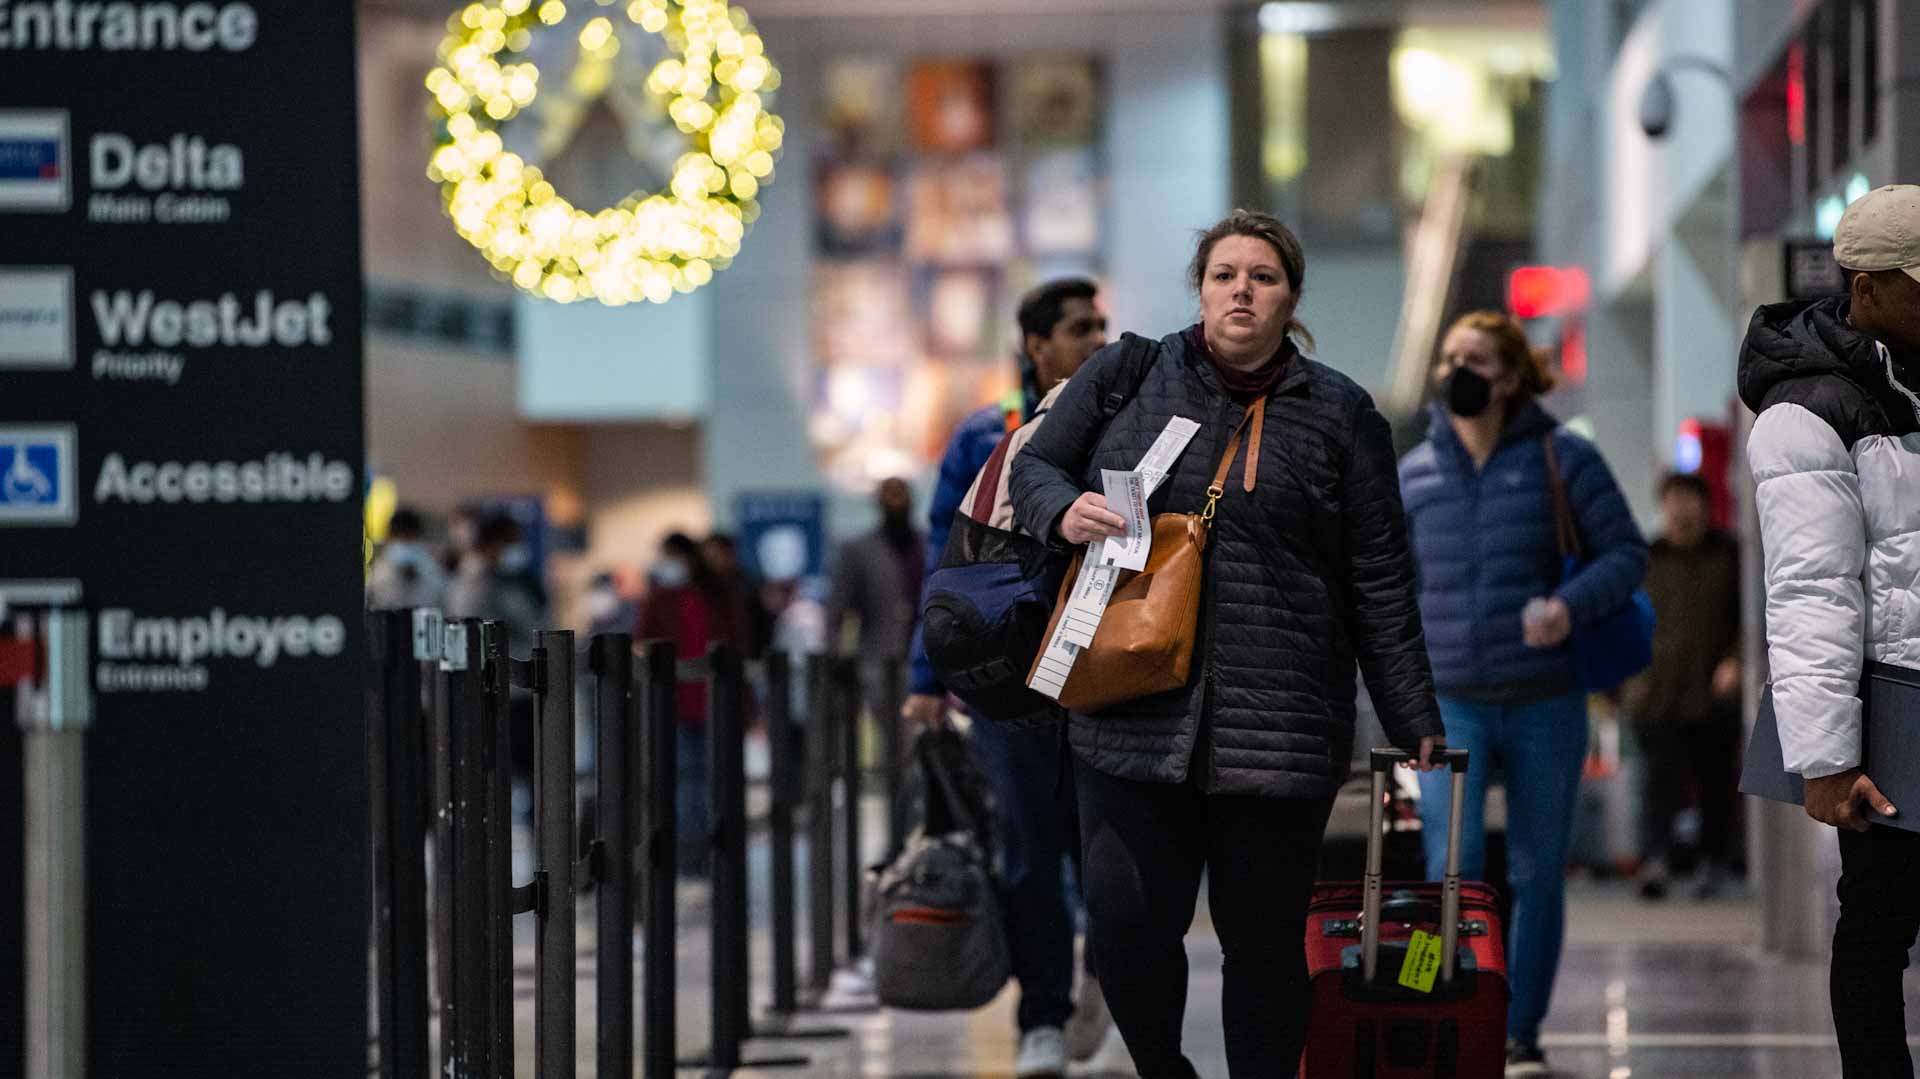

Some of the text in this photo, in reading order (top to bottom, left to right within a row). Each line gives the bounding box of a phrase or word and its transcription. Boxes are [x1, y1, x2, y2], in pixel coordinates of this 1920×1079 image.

[90, 133, 243, 189] Delta
[89, 194, 229, 221] Main Cabin
[92, 290, 330, 346] WestJet
[93, 351, 183, 382] Priority
[96, 453, 352, 502] Accessible
[99, 608, 344, 667] Employee
